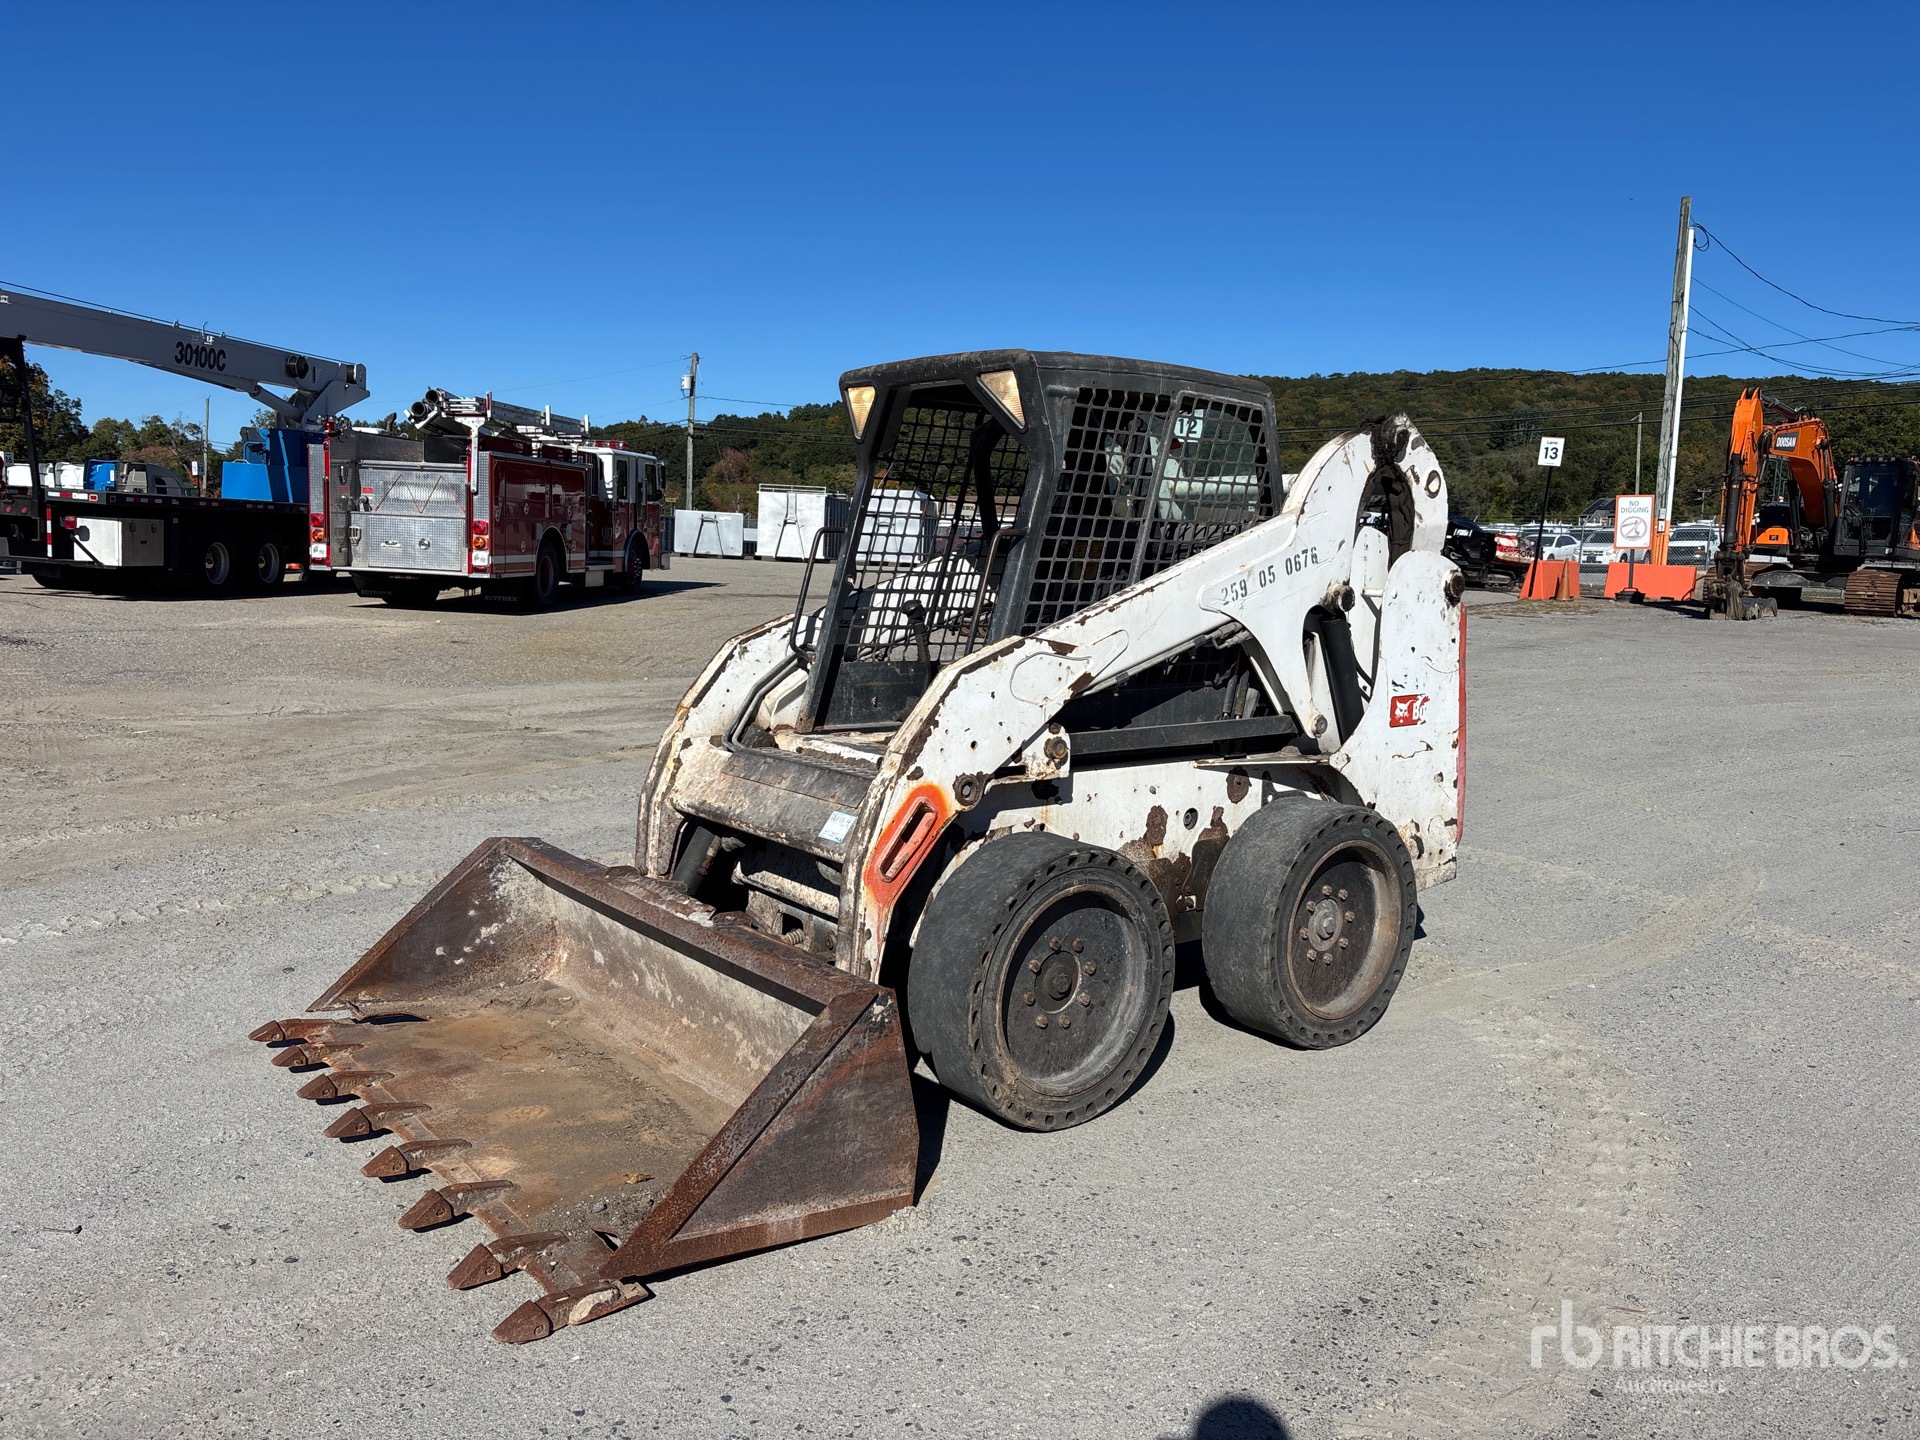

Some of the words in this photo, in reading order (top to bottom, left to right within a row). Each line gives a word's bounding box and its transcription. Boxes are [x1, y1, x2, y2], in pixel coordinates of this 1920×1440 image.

[174, 341, 226, 372] 30100C
[1178, 418, 1198, 434] 12
[1776, 436, 1797, 448] DOOSAN
[1544, 446, 1558, 460] 13
[1221, 578, 1248, 606] 259
[1259, 565, 1276, 588] 05
[1285, 546, 1319, 576] 0676
